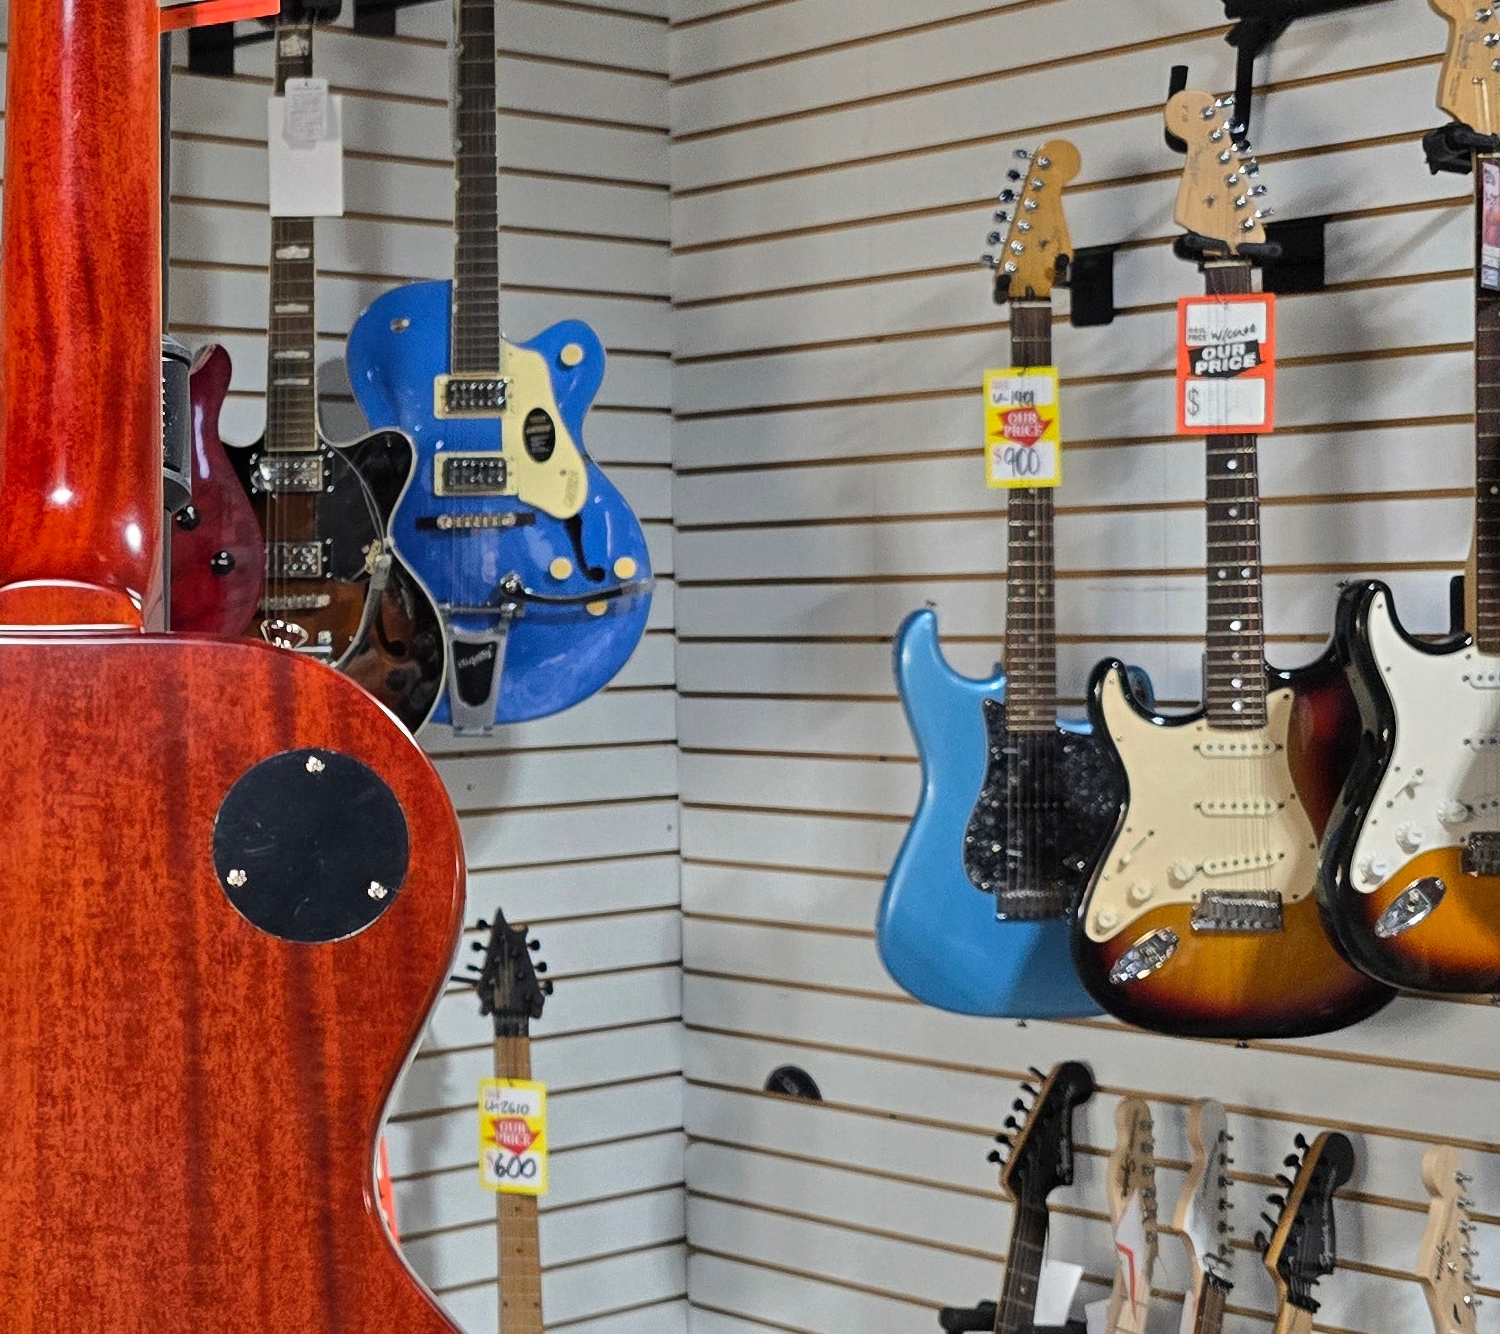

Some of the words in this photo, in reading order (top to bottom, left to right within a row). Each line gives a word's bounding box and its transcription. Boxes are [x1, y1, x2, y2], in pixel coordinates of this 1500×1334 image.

[1202, 343, 1246, 360] OUR
[1195, 353, 1256, 375] PRICE
[1008, 412, 1037, 424] OUR
[1004, 424, 1043, 437] PRICE
[499, 1122, 527, 1134] OUR
[496, 1132, 532, 1146] PRICE
